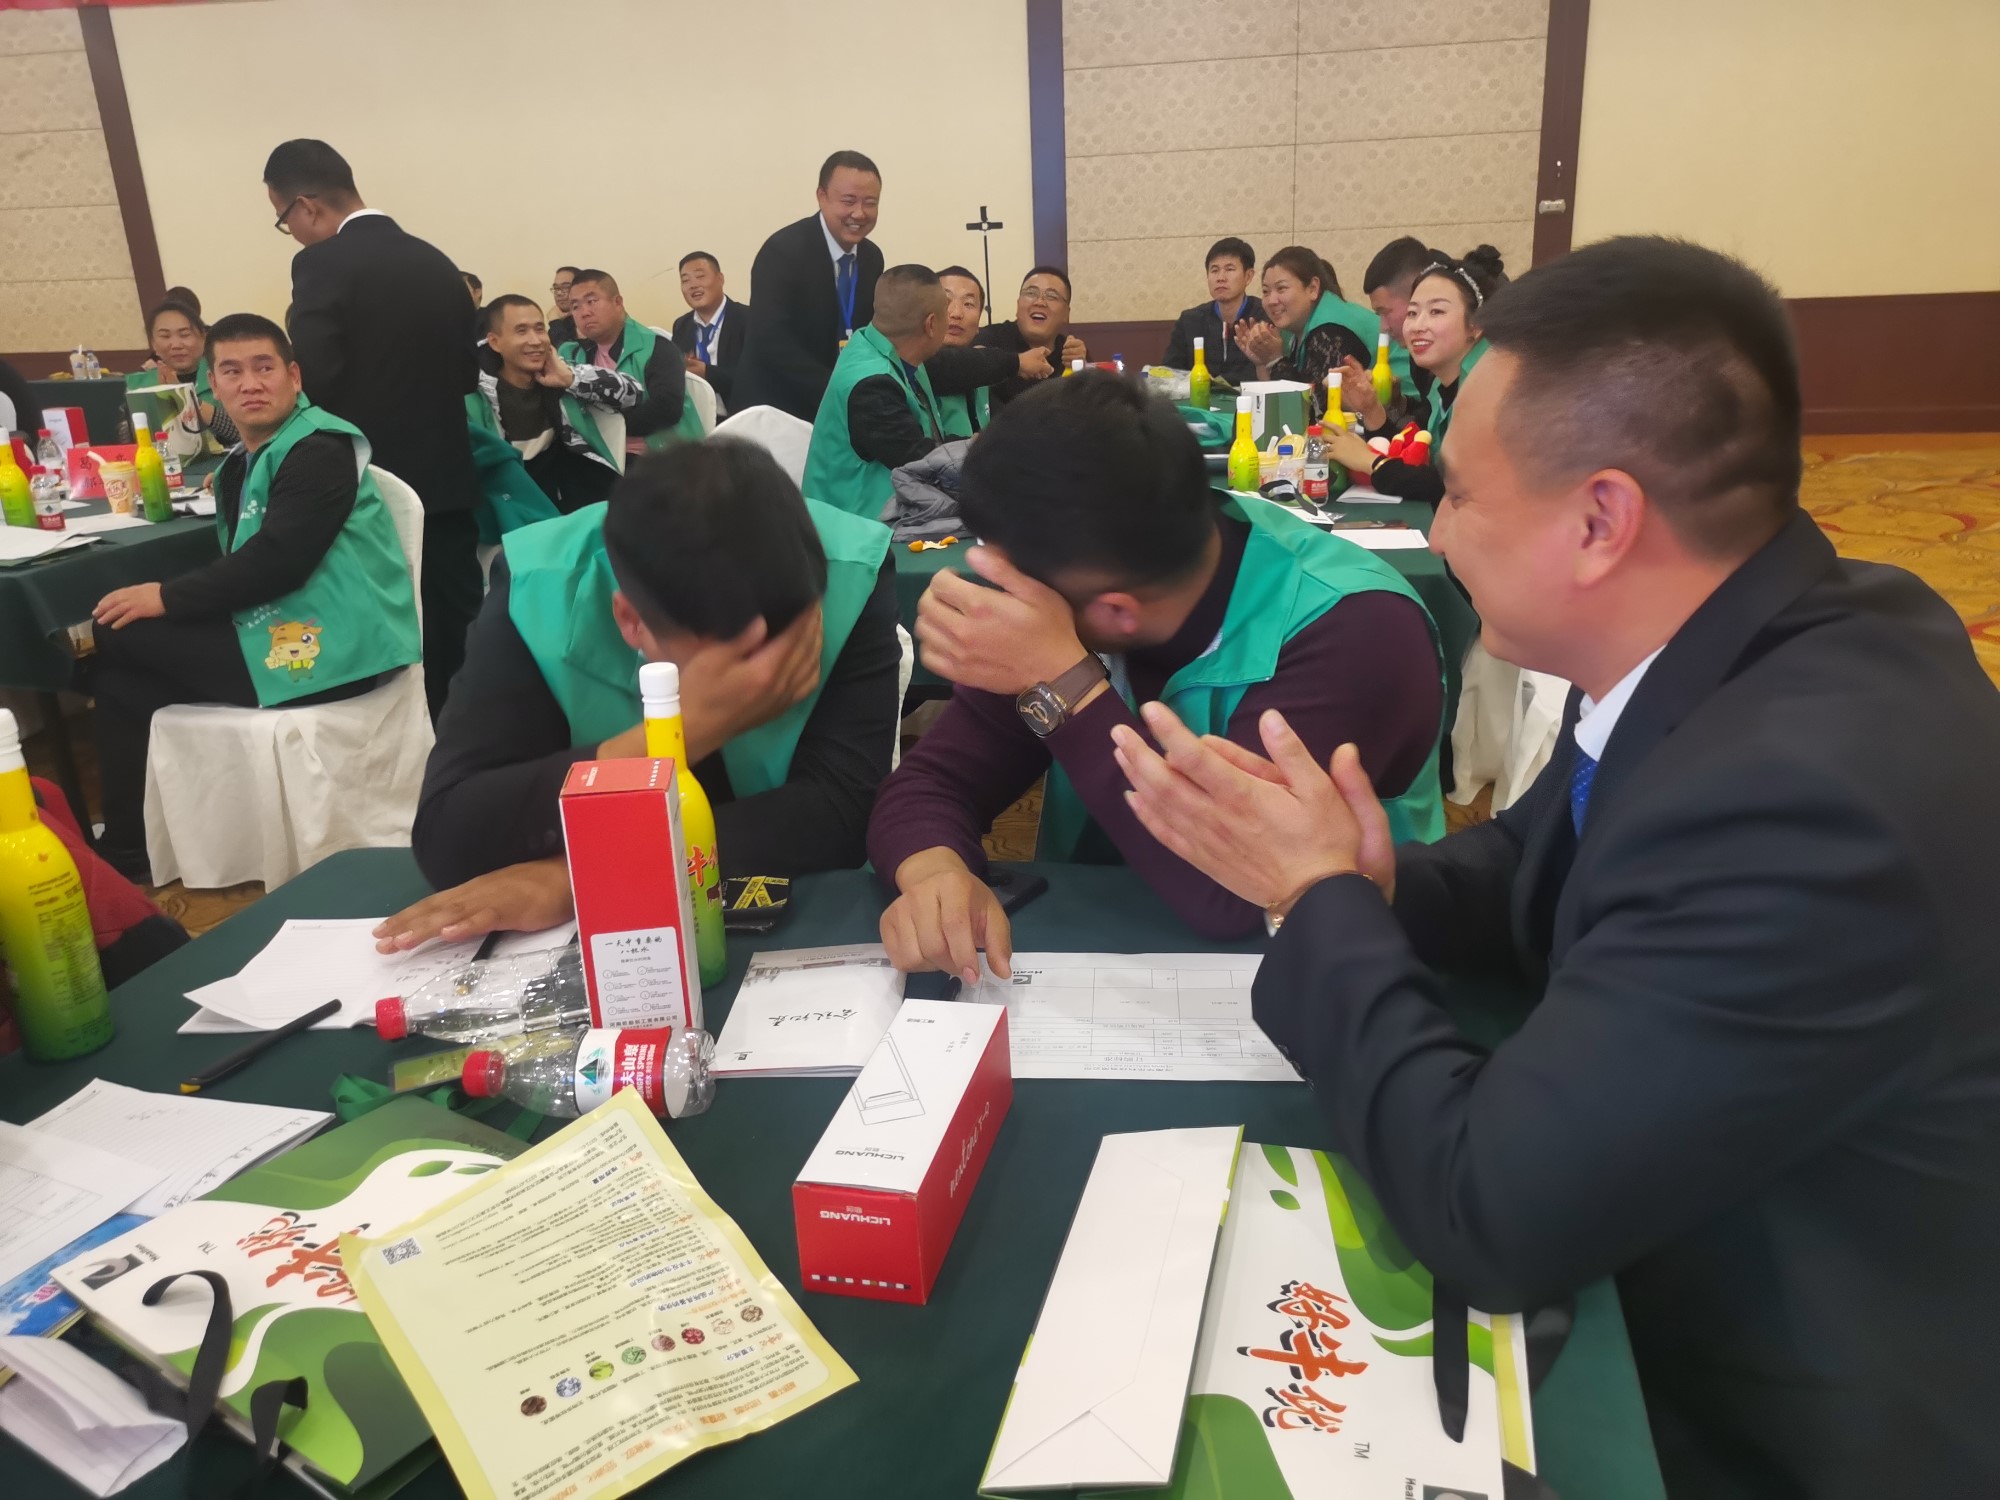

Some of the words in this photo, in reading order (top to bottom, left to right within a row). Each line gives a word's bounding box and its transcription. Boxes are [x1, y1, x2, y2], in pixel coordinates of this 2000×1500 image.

[620, 1043, 639, 1089] 夫山泉
[637, 1044, 648, 1070] SPRING
[835, 1149, 904, 1161] LICHUANG
[819, 1210, 891, 1225] LICHUANG
[1354, 1441, 1370, 1460] TM
